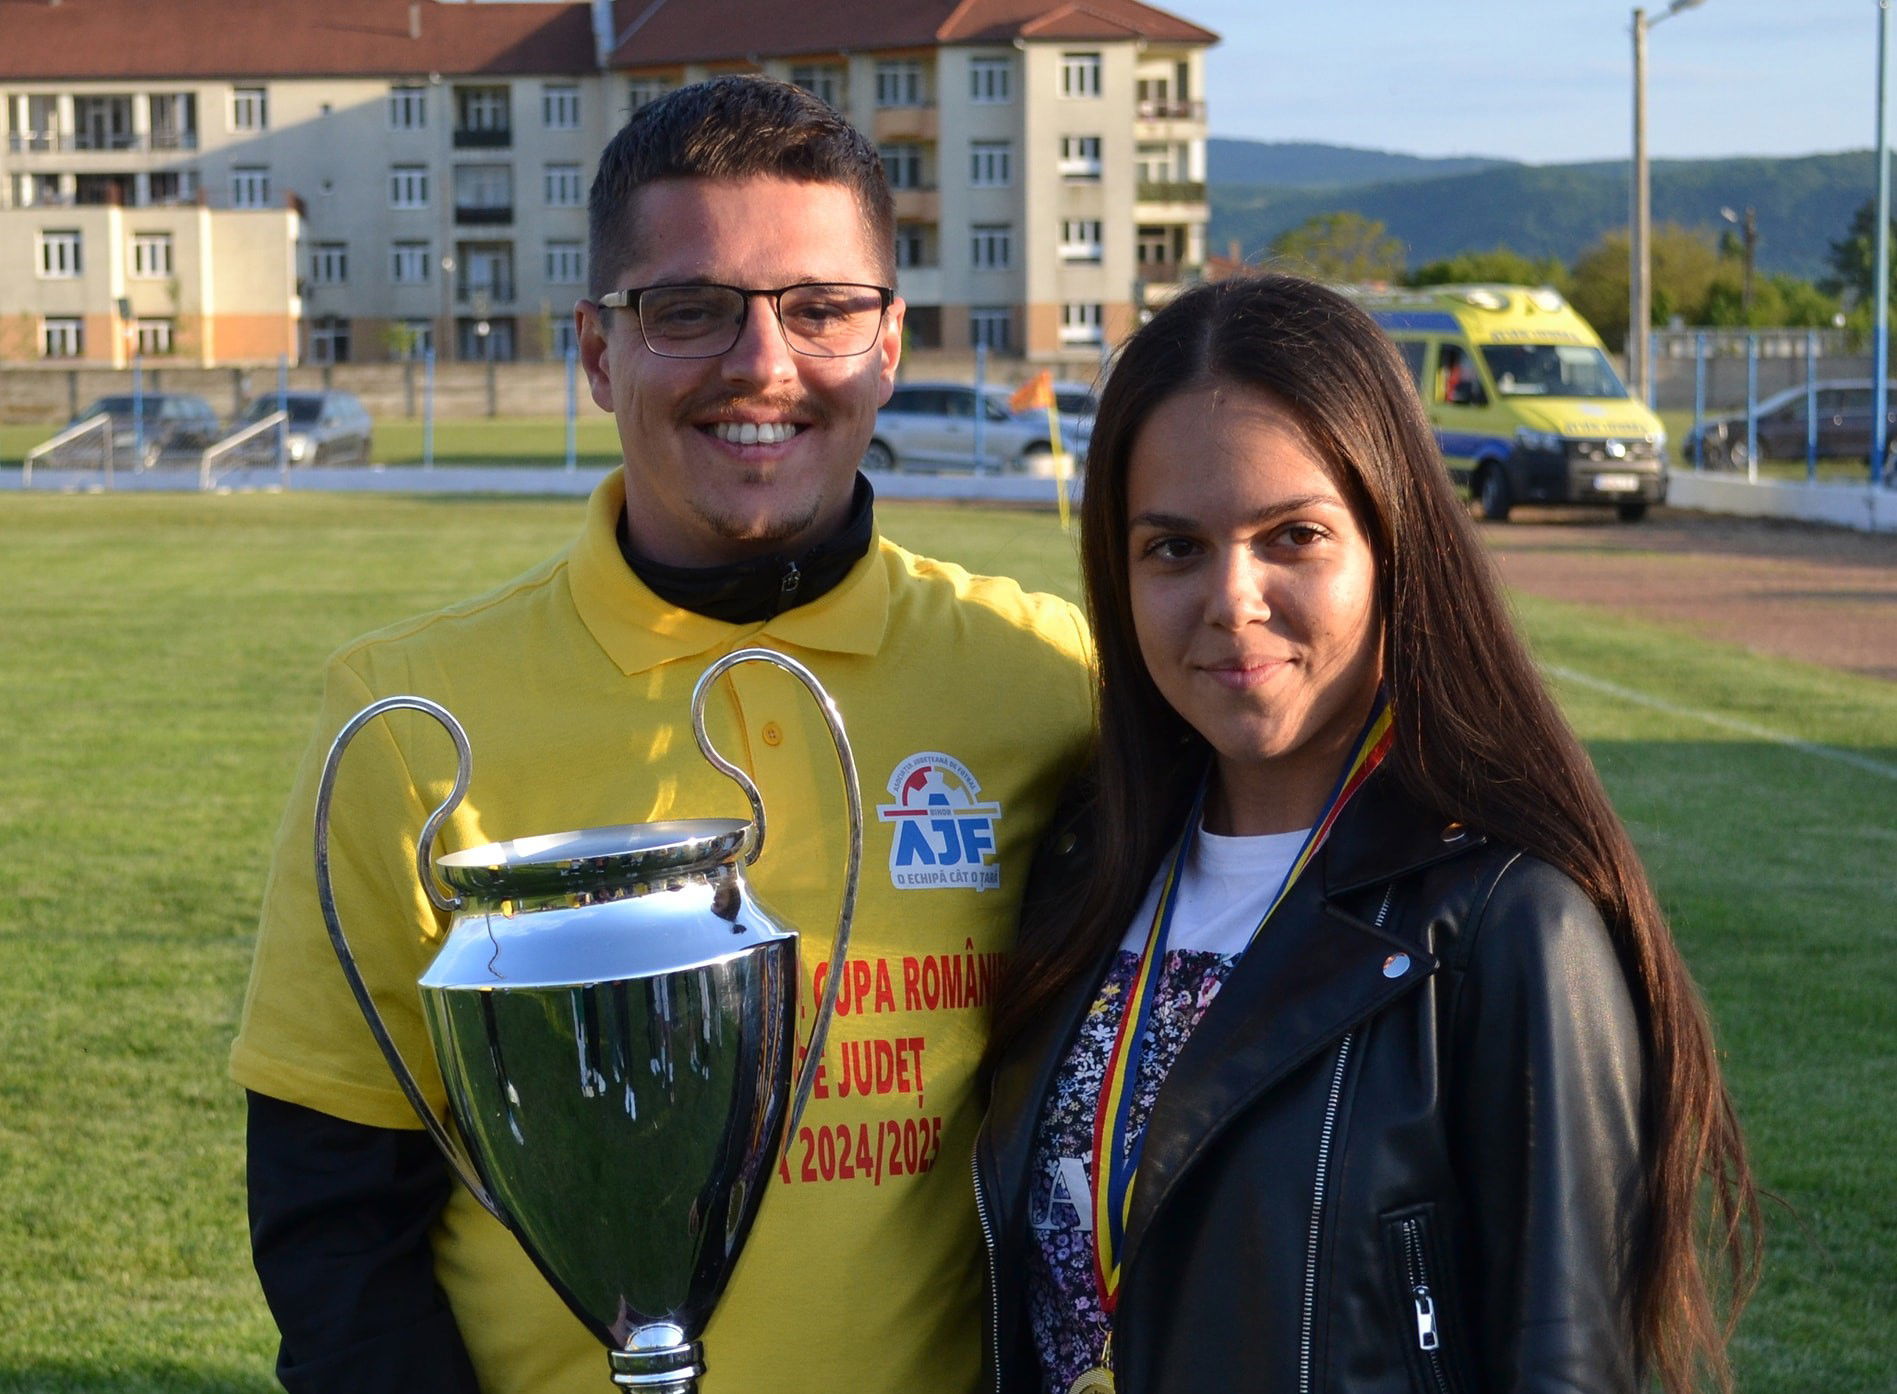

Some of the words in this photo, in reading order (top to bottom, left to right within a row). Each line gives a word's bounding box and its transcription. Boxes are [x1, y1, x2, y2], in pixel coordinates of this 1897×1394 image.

[896, 818, 992, 866] AJF
[897, 874, 905, 884] O
[907, 870, 947, 884] ECHIPĂ
[971, 872, 978, 882] O
[838, 1037, 925, 1109] JUDEȚ
[800, 1117, 942, 1186] 2024/2025
